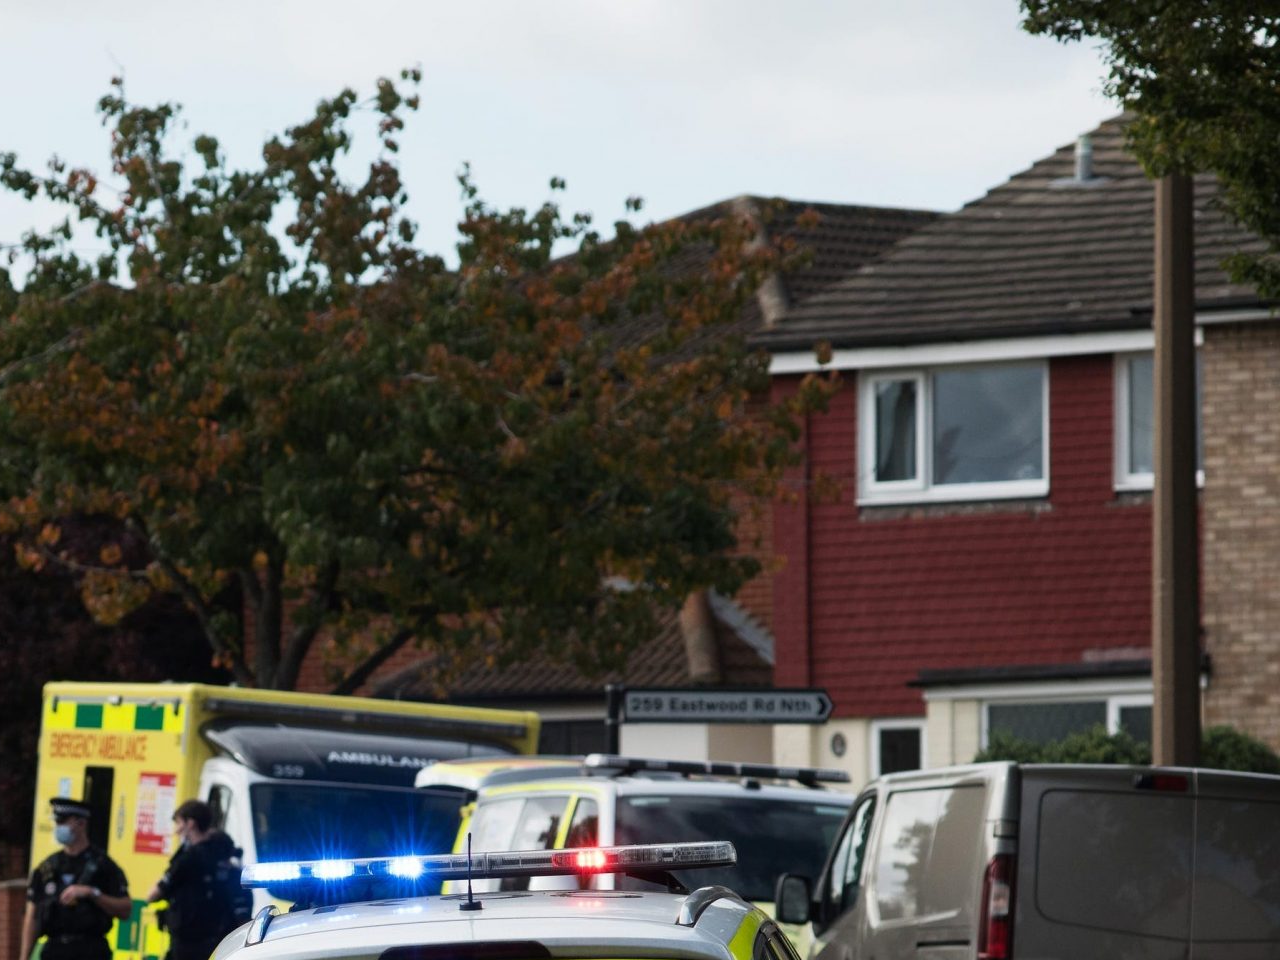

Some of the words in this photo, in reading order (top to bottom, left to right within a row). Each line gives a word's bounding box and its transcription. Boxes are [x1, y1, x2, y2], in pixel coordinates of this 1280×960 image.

[631, 697, 663, 713] 259
[670, 697, 748, 713] Eastwood
[752, 698, 776, 714] Rd
[780, 698, 813, 714] Nth
